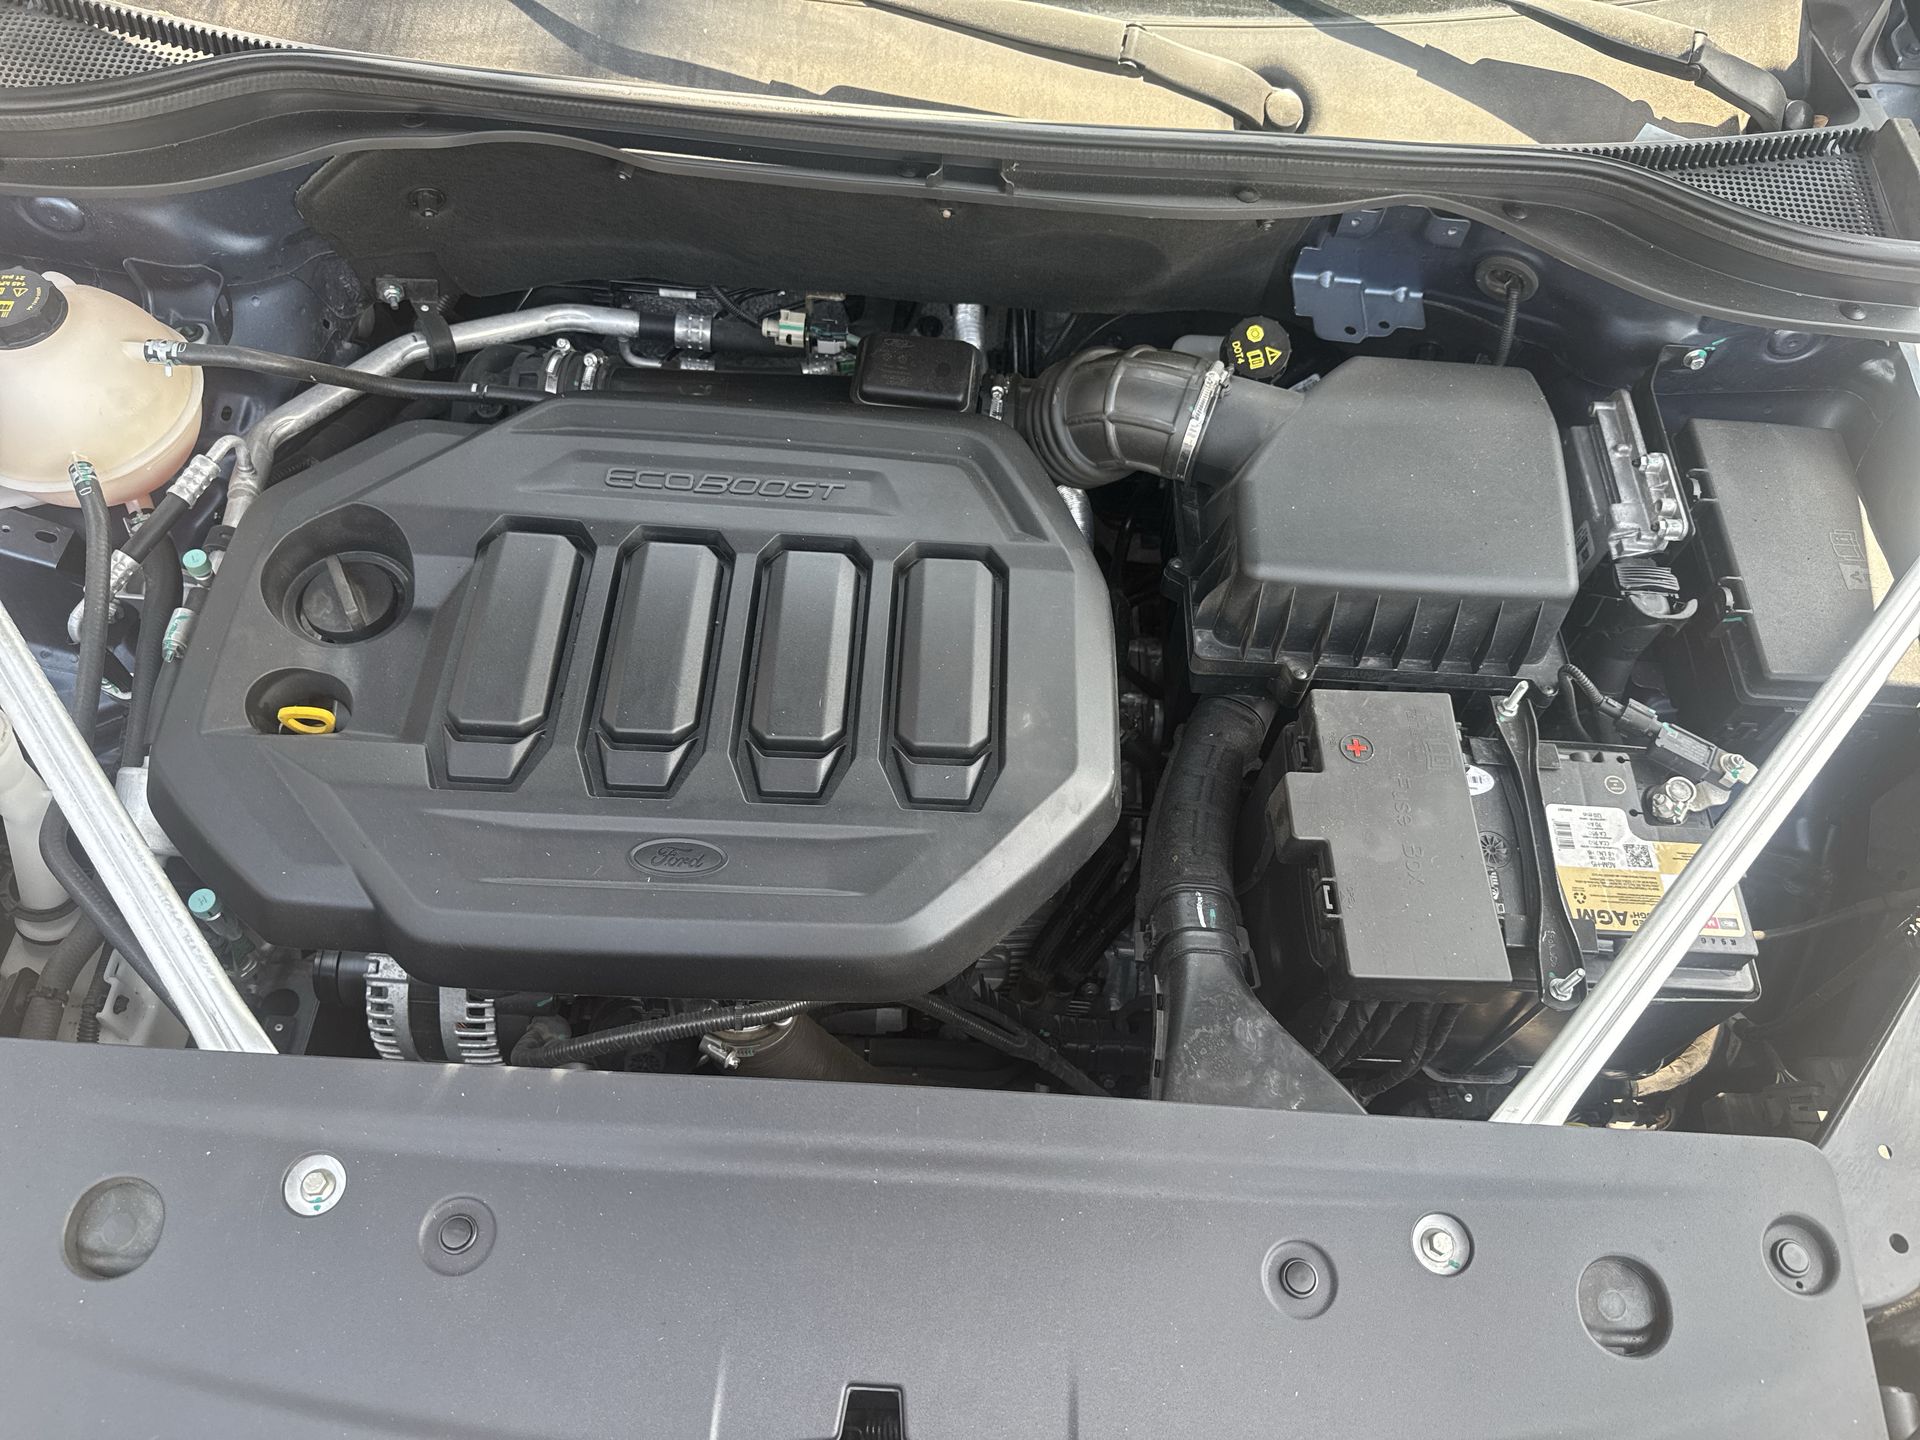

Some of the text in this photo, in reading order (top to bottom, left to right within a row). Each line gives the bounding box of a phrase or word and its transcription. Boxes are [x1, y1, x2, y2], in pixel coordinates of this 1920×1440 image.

[604, 466, 846, 500] ECOBOOST
[650, 846, 705, 868] Ford
[1575, 908, 1628, 926] AGM
